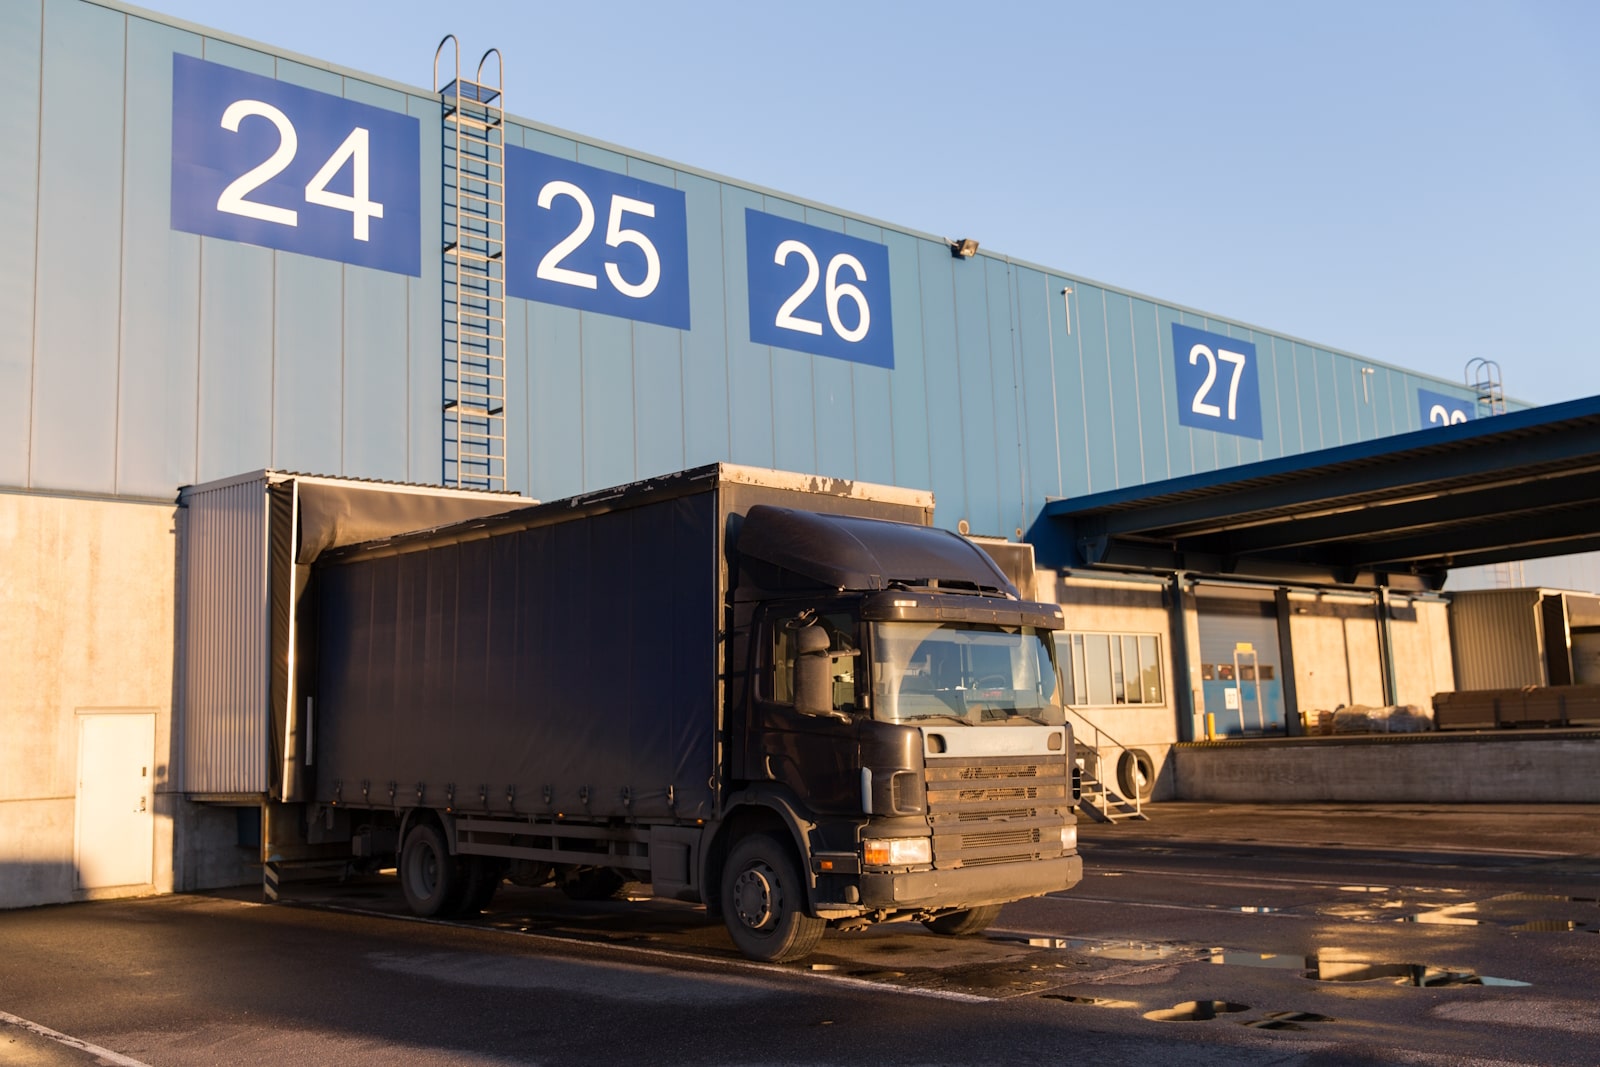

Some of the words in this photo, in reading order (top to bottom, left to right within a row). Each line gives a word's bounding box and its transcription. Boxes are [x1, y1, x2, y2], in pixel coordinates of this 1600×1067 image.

[216, 99, 384, 242] 24
[536, 180, 661, 299] 25
[774, 239, 871, 343] 26
[1188, 343, 1246, 421] 27
